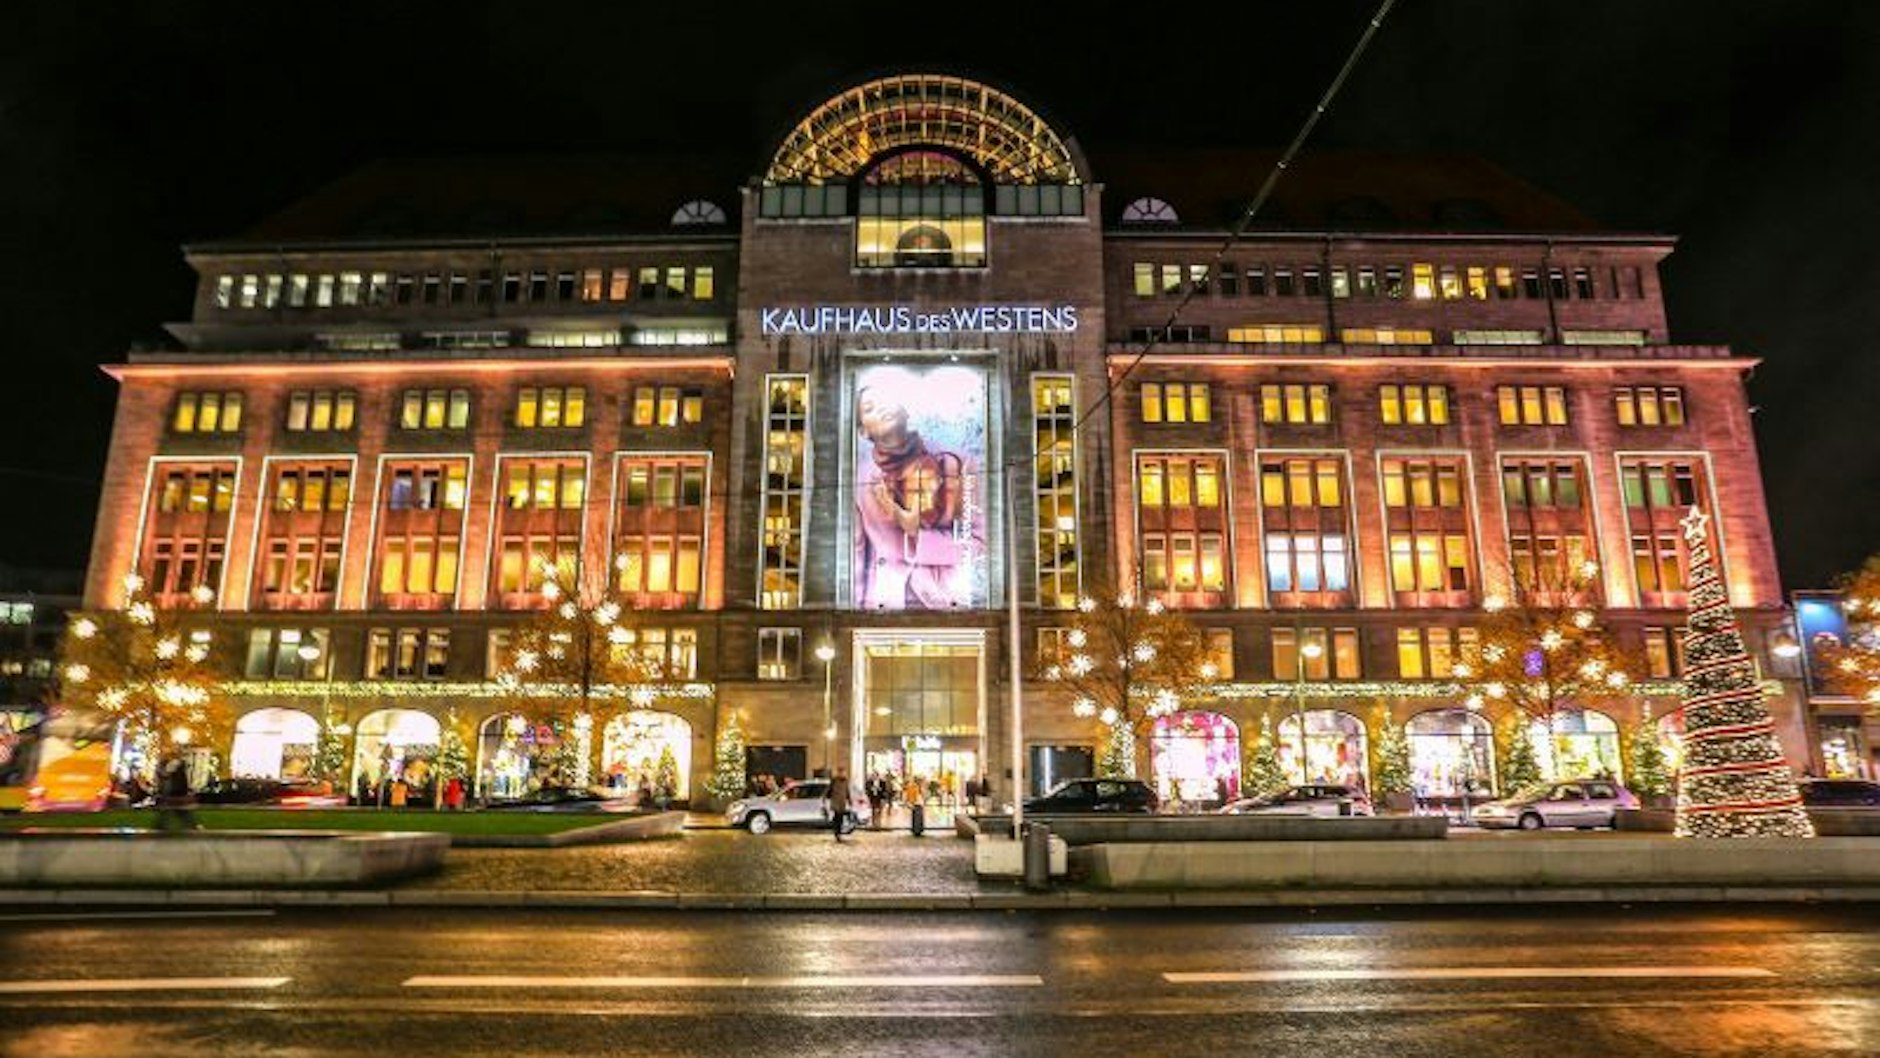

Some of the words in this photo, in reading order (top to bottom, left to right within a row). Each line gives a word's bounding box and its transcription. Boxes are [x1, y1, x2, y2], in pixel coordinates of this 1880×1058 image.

[762, 306, 911, 334] KAUFHAUS
[915, 314, 951, 333] DES
[950, 306, 1078, 333] WESTENS
